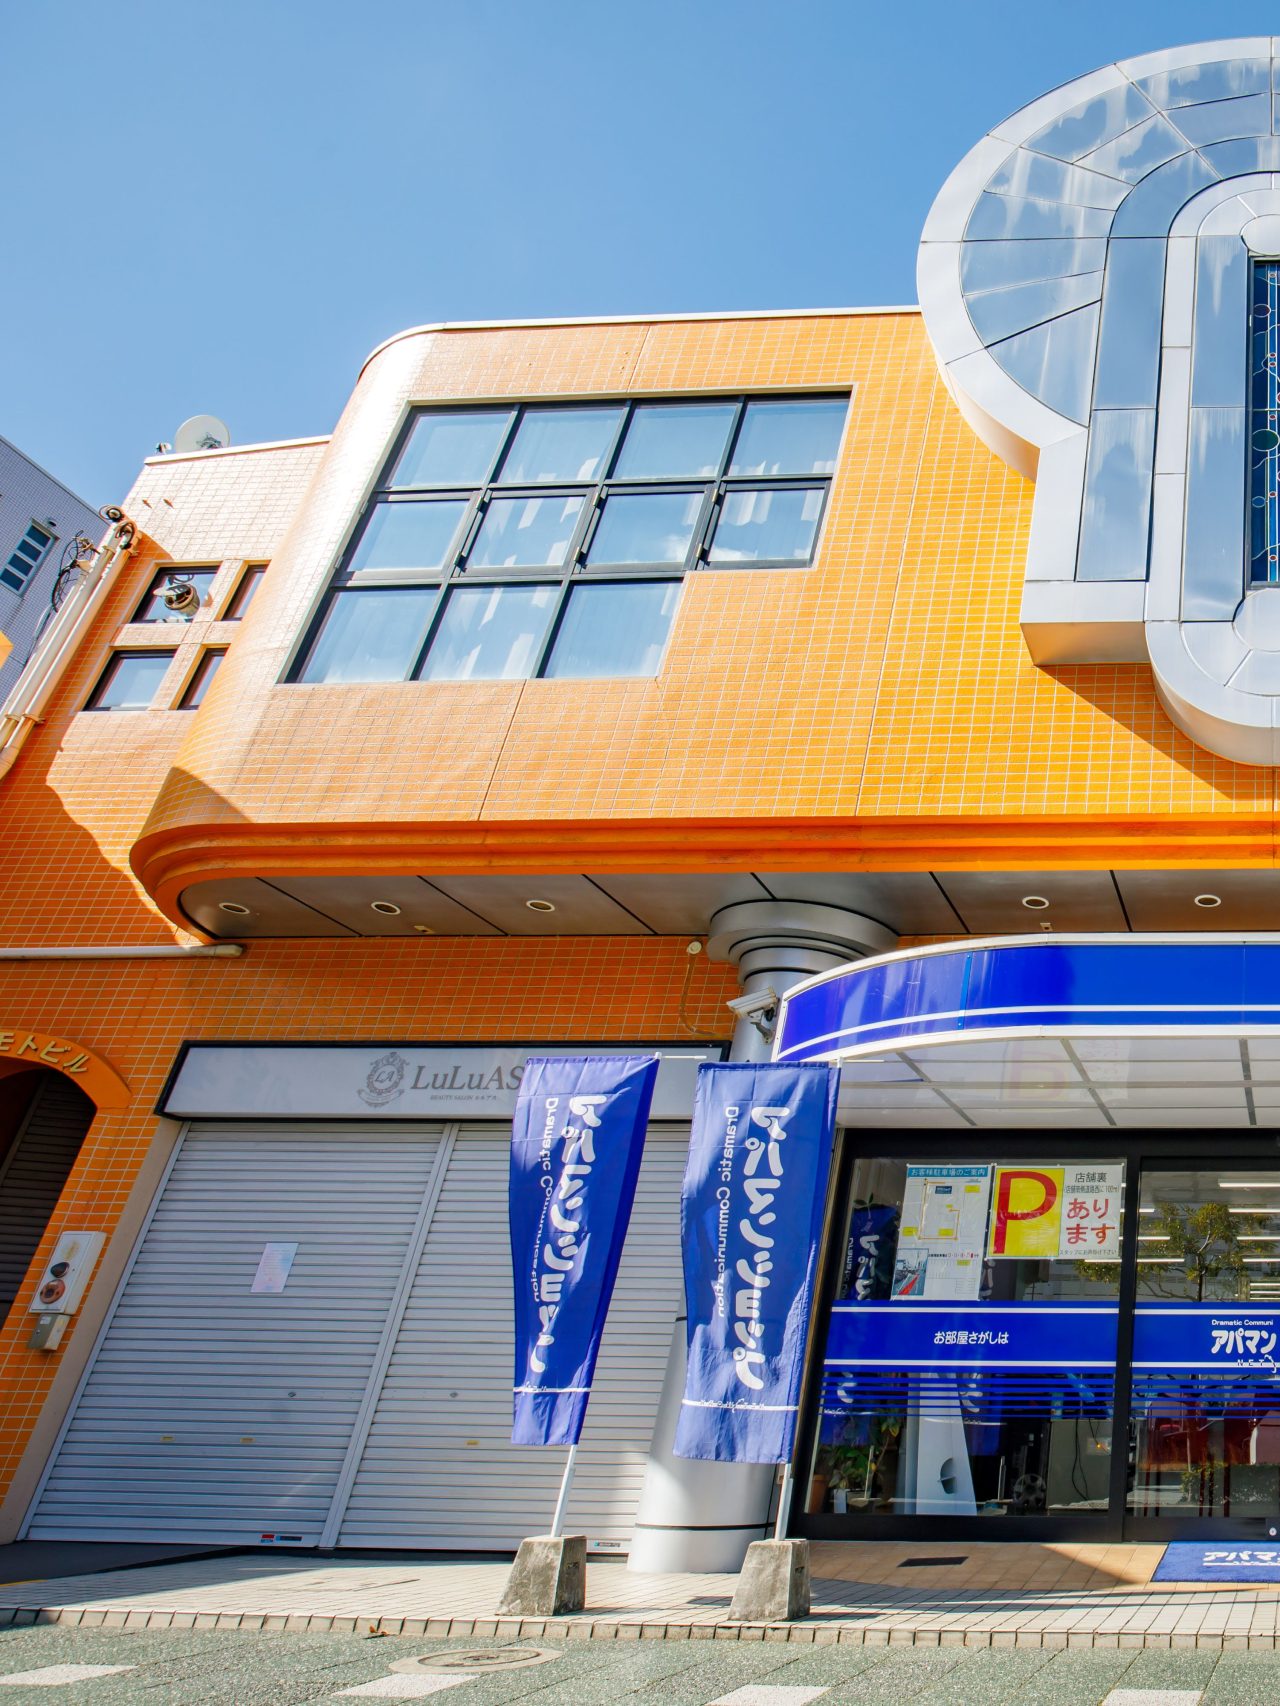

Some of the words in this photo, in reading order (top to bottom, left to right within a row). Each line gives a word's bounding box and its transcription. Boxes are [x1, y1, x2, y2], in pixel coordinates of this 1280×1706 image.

[992, 1170, 1058, 1255] P
[1066, 1198, 1110, 1220] あり
[1065, 1223, 1116, 1245] ます
[933, 1330, 1009, 1345] お部屋さがしは
[1211, 1327, 1277, 1354] アパマン
